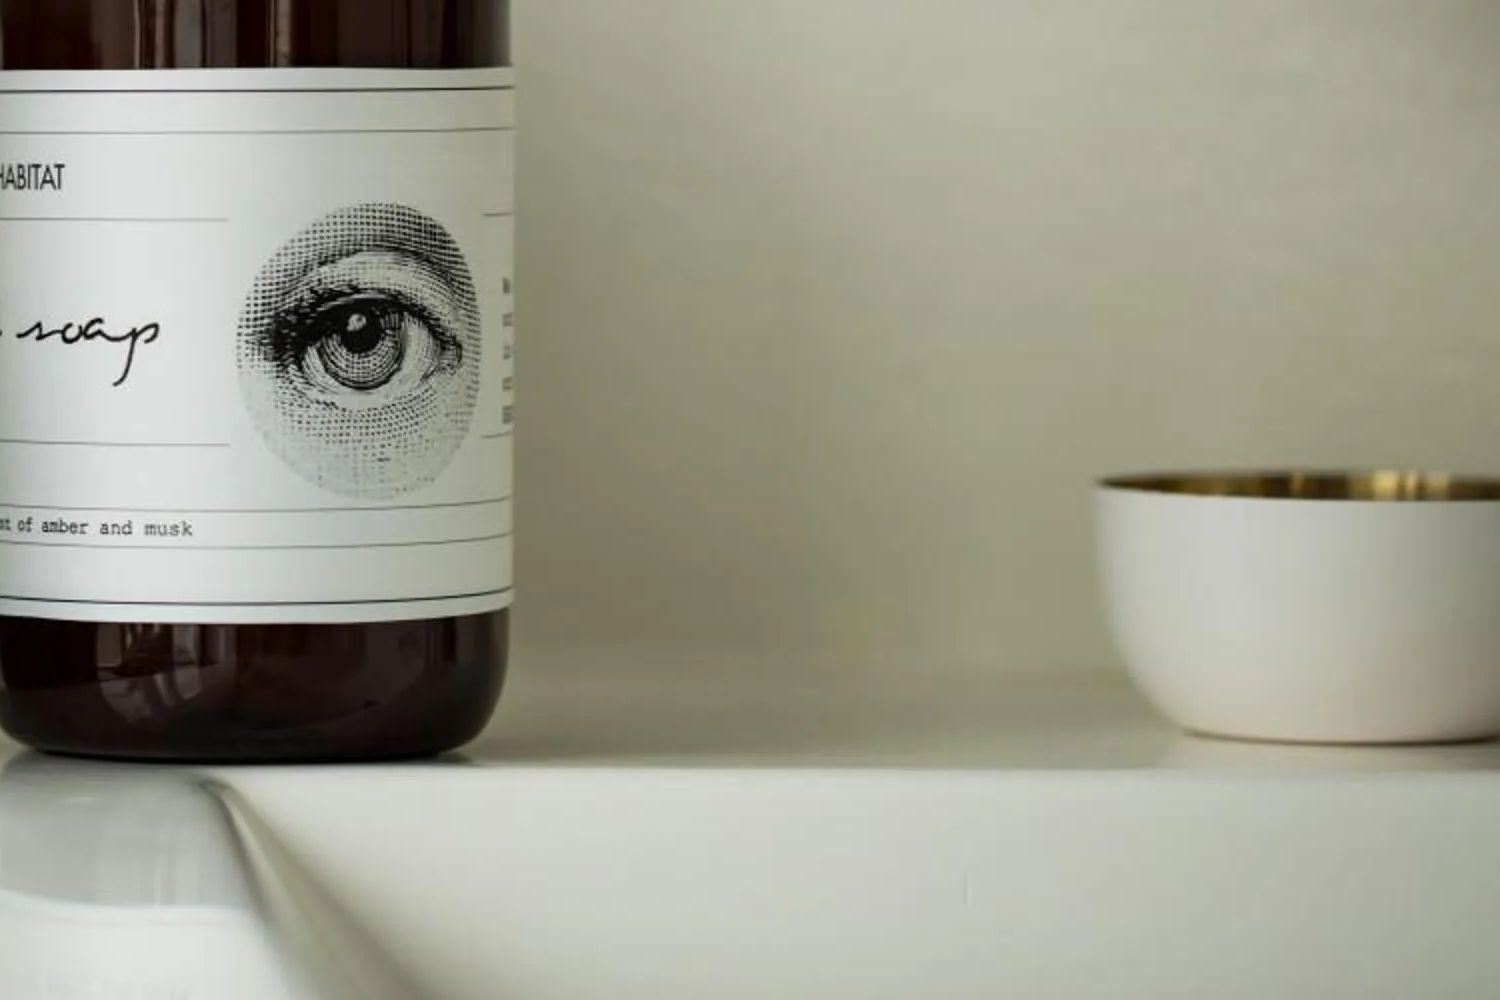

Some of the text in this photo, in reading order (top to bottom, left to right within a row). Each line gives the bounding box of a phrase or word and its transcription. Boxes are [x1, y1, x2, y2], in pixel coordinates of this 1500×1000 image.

[15, 316, 160, 387] soap
[17, 516, 34, 533] of
[41, 517, 89, 535] amber
[99, 519, 133, 536] and
[143, 520, 193, 537] musk
